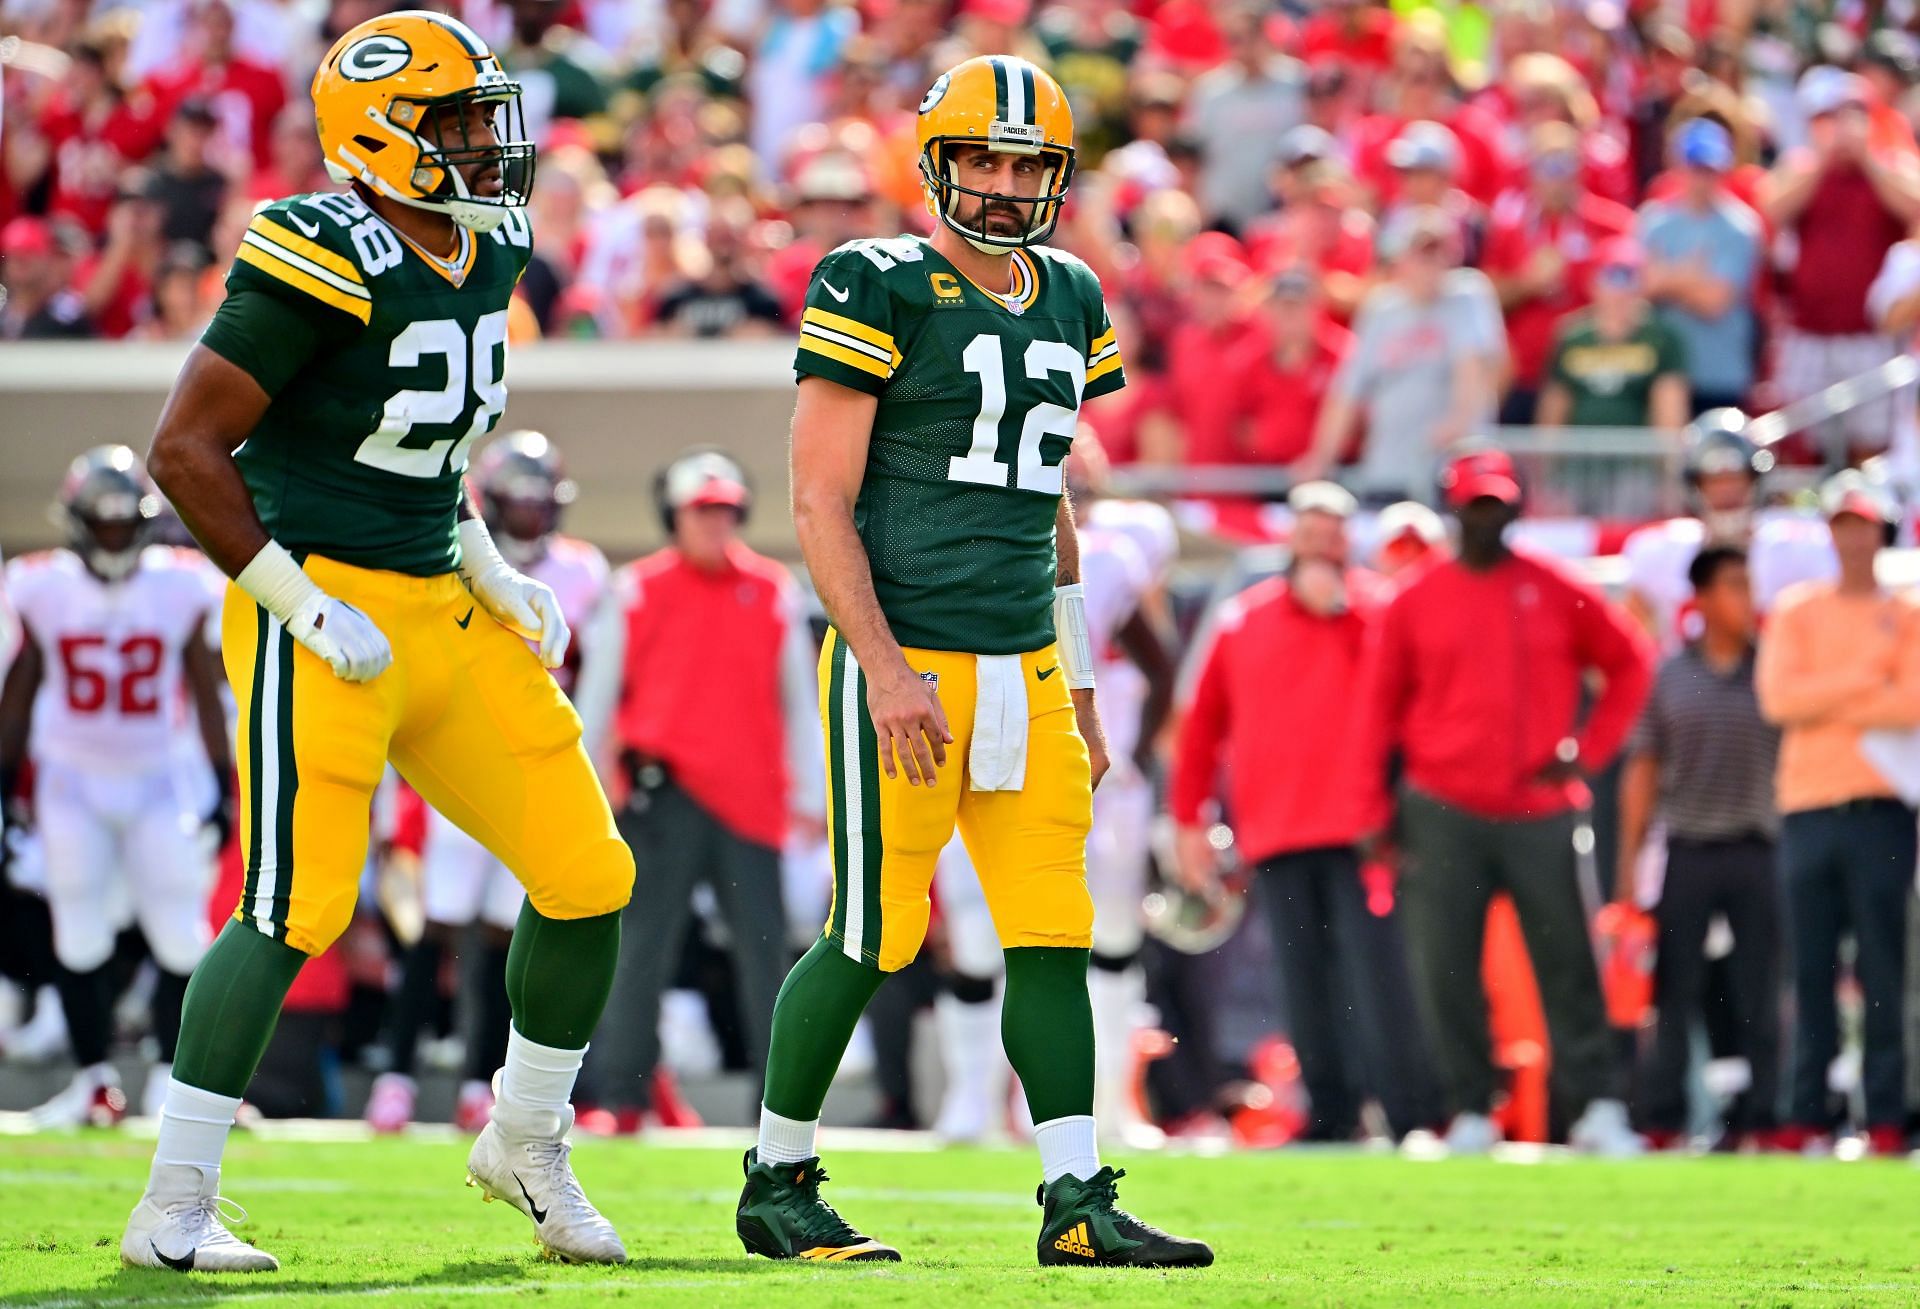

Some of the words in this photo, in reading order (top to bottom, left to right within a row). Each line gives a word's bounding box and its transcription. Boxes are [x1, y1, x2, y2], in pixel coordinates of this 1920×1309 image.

[339, 34, 412, 82] G
[1003, 125, 1028, 136] PACKERS
[300, 189, 403, 276] 28
[930, 273, 962, 298] C
[353, 309, 508, 478] 28
[947, 333, 1087, 494] 12
[59, 634, 164, 714] 52
[1054, 1239, 1096, 1258] adidas
